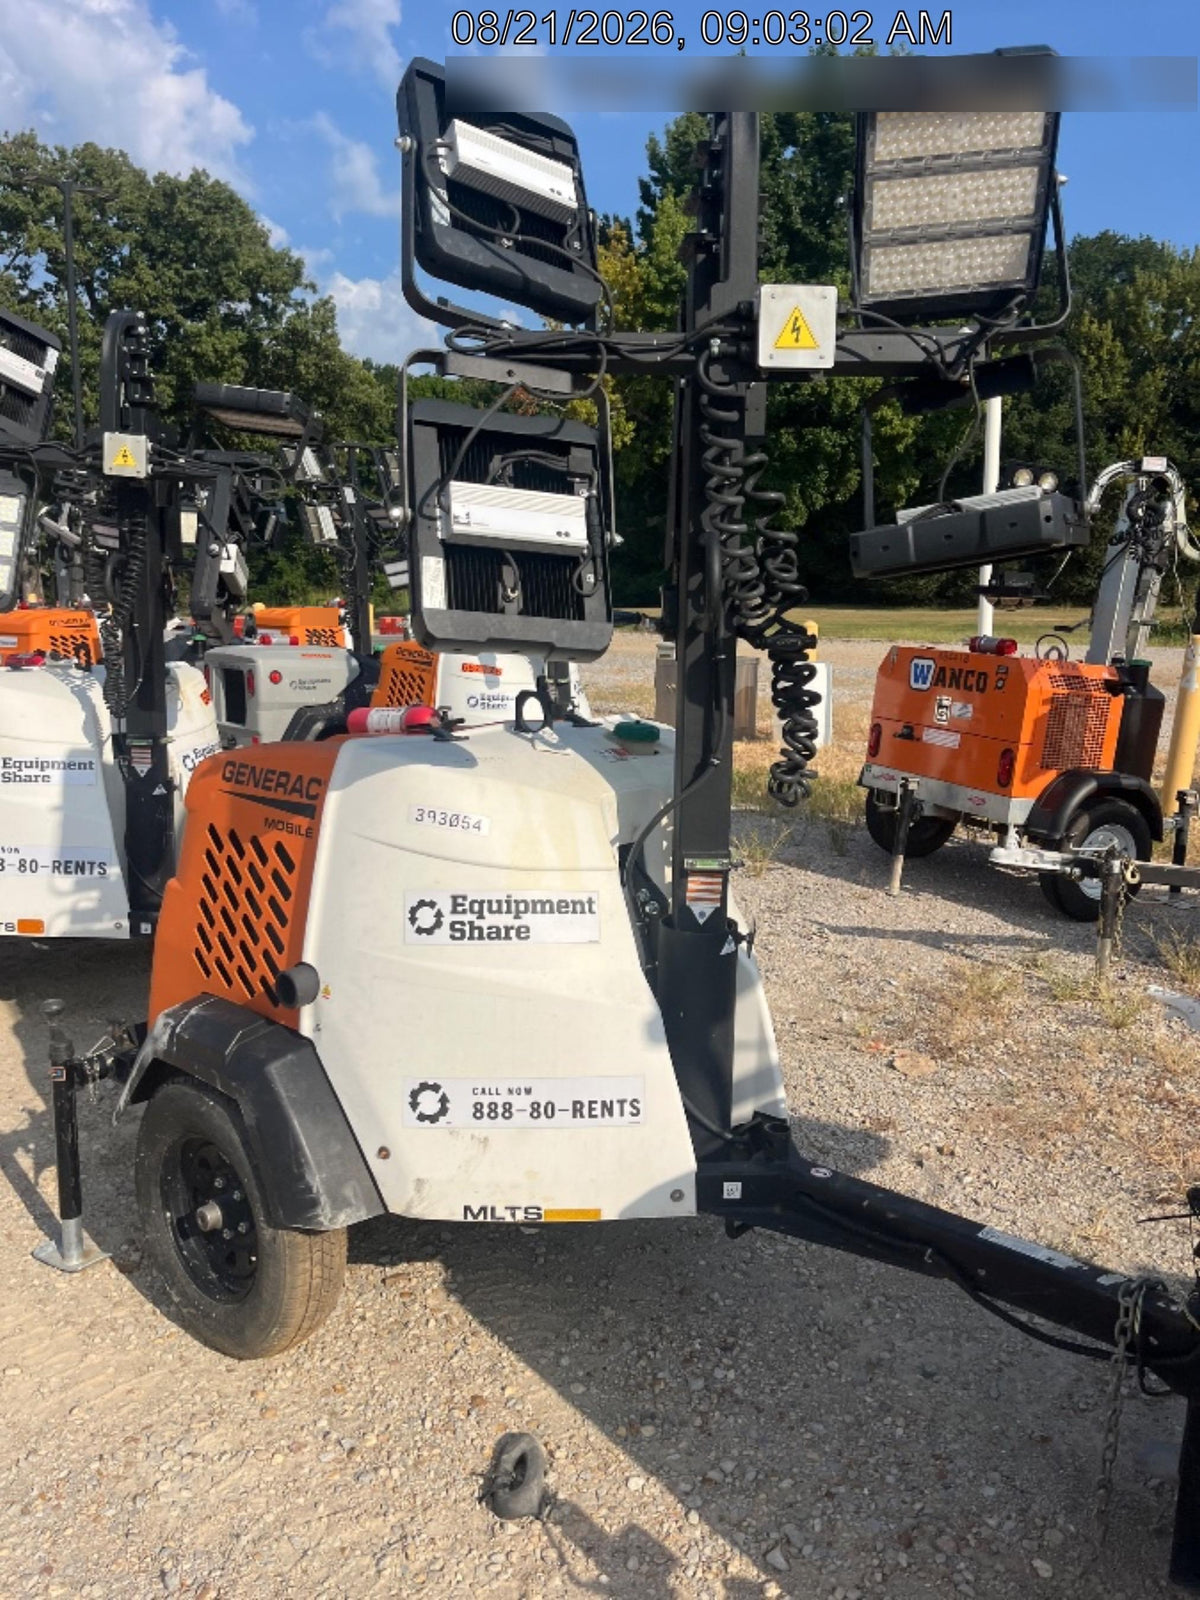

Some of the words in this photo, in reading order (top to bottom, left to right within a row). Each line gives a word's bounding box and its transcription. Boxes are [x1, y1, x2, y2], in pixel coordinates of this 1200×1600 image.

[910, 656, 988, 694] WANCO
[1, 757, 95, 772] Equipment
[1, 771, 51, 783] Share
[222, 760, 322, 801] GENERAC
[264, 817, 314, 838] MOBILE
[450, 894, 596, 920] Equipment
[449, 920, 531, 942] Share
[472, 1087, 501, 1096] CALL
[507, 1087, 533, 1096] NOW
[472, 1098, 641, 1121] 888-80-RENTS
[463, 1205, 543, 1221] MLTS
